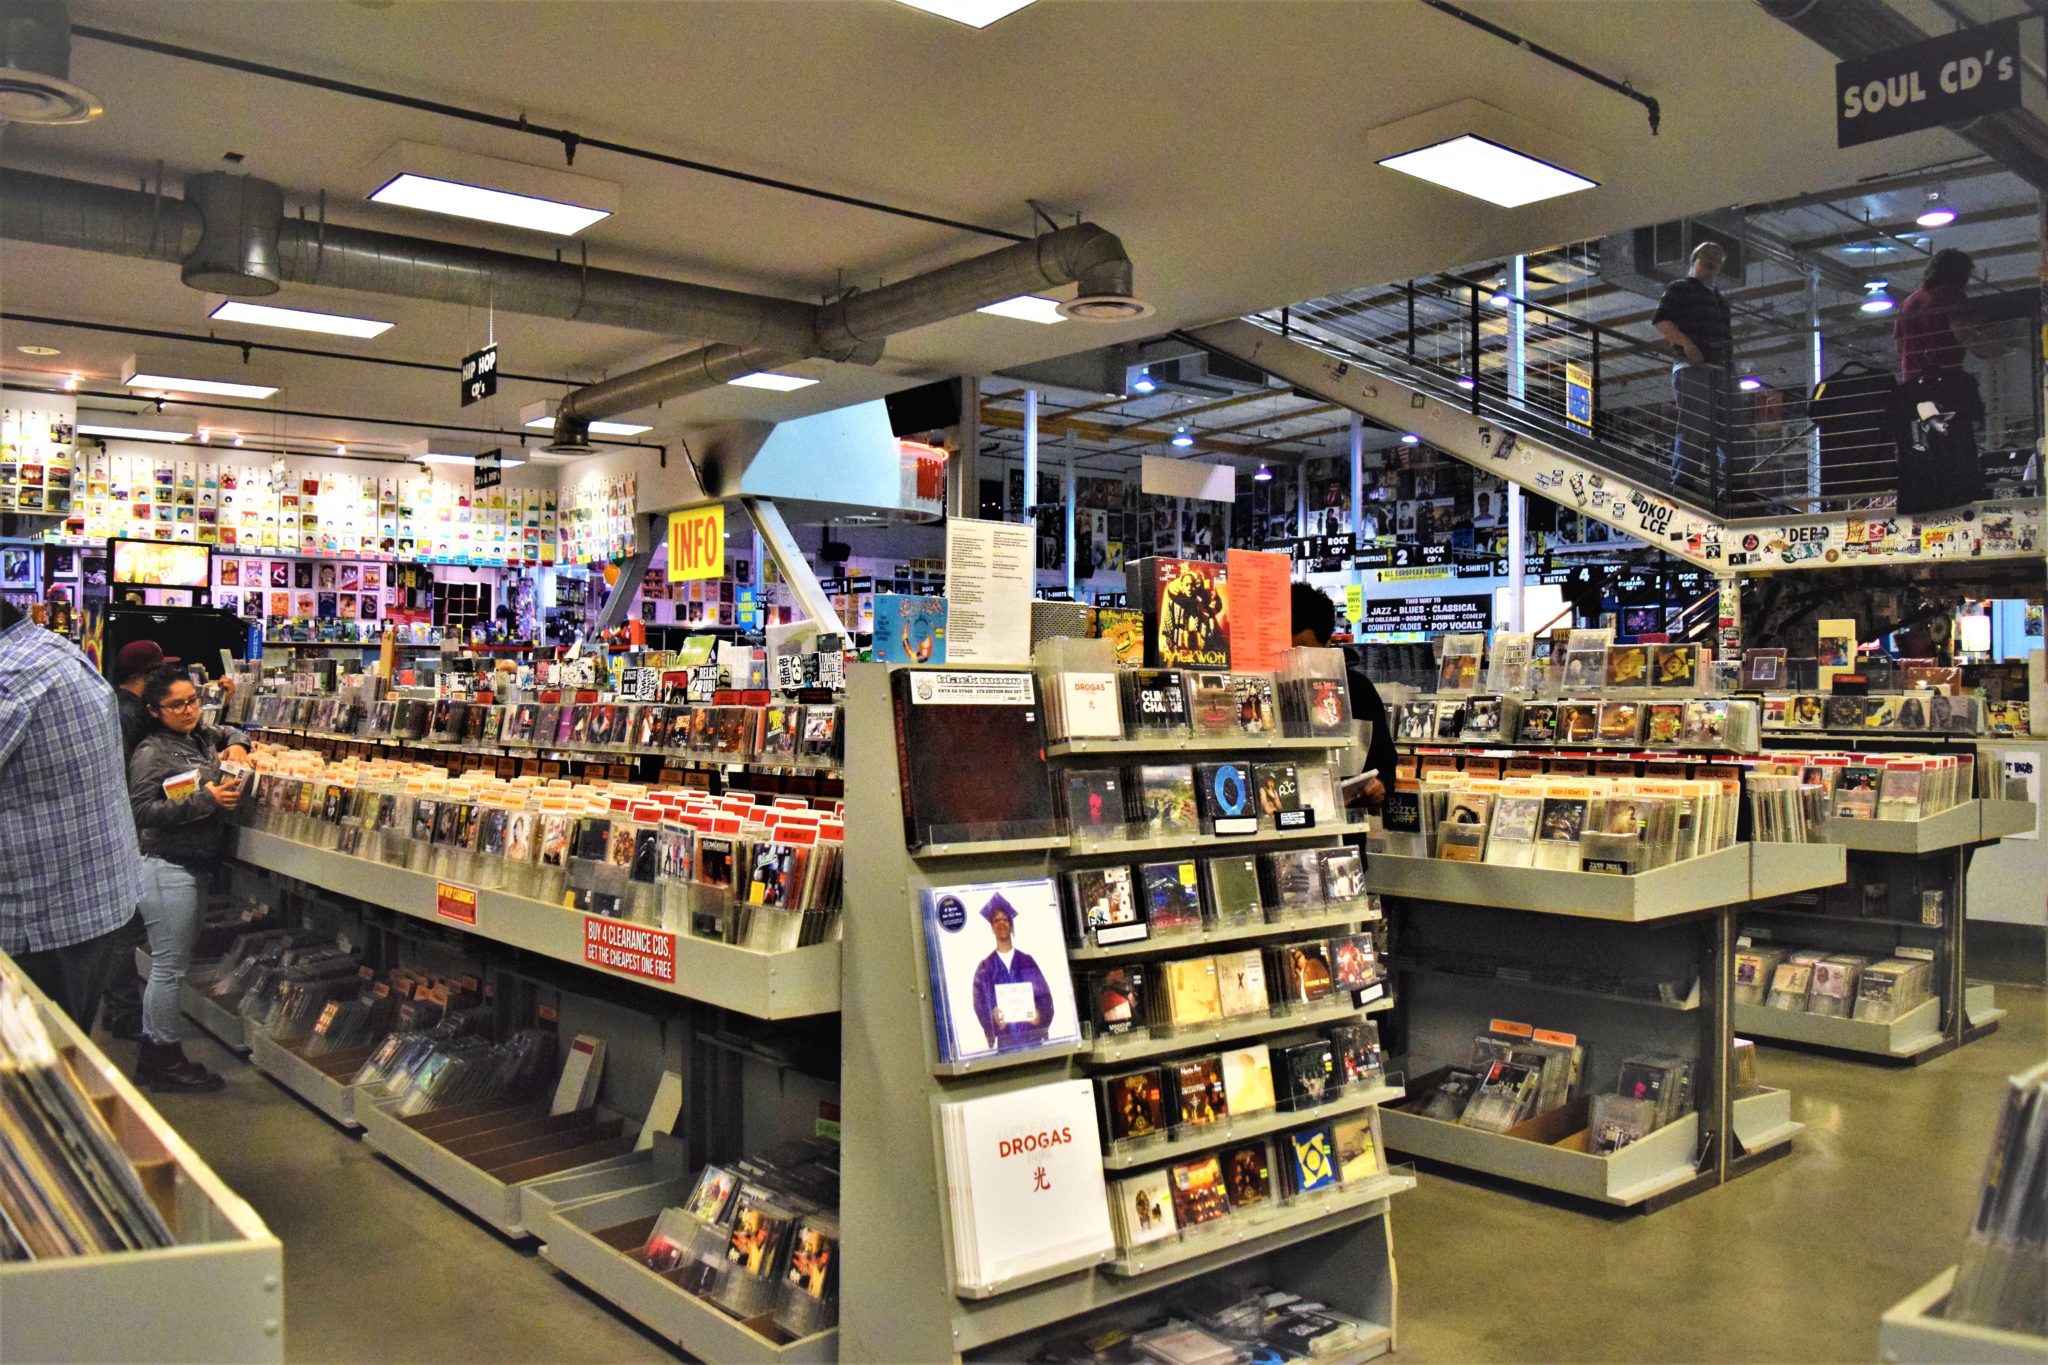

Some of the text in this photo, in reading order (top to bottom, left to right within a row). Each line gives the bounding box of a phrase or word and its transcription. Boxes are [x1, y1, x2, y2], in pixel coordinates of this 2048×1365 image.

[1844, 49, 2014, 119] SOUL CD's
[462, 351, 496, 382] HIP HOP
[471, 380, 485, 397] CD's
[1640, 516, 1668, 535] LCE
[674, 515, 717, 571] INFO
[1328, 536, 1349, 546] ROCK
[1303, 540, 1310, 557] 1
[1331, 546, 1346, 555] CD's
[1423, 546, 1444, 555] ROCK
[1396, 549, 1408, 565] 2
[1426, 555, 1441, 563] CD's
[1395, 568, 1423, 576] EUROPEAN
[1424, 566, 1448, 575] POSTERS
[1458, 564, 1489, 573] T-SHIRTS
[1497, 559, 1508, 574] 3
[1544, 576, 1568, 584] METAL
[1579, 568, 1590, 582] 4
[1119, 595, 1126, 605] 4
[1371, 604, 1477, 615] JAZZ BLUES CLASSICAL
[741, 613, 753, 622] HERE
[1367, 621, 1483, 631] COUNTRY OLDIES POP VOCALS
[936, 675, 1021, 685] black moon
[1074, 683, 1105, 692] DROGAS
[588, 920, 671, 960] BUY 4 CLEARANCE CDS,
[588, 943, 672, 979] GET THE CHEAPEST ONE FREE
[999, 1127, 1072, 1158] DROGAS
[1033, 1166, 1051, 1193] 光
